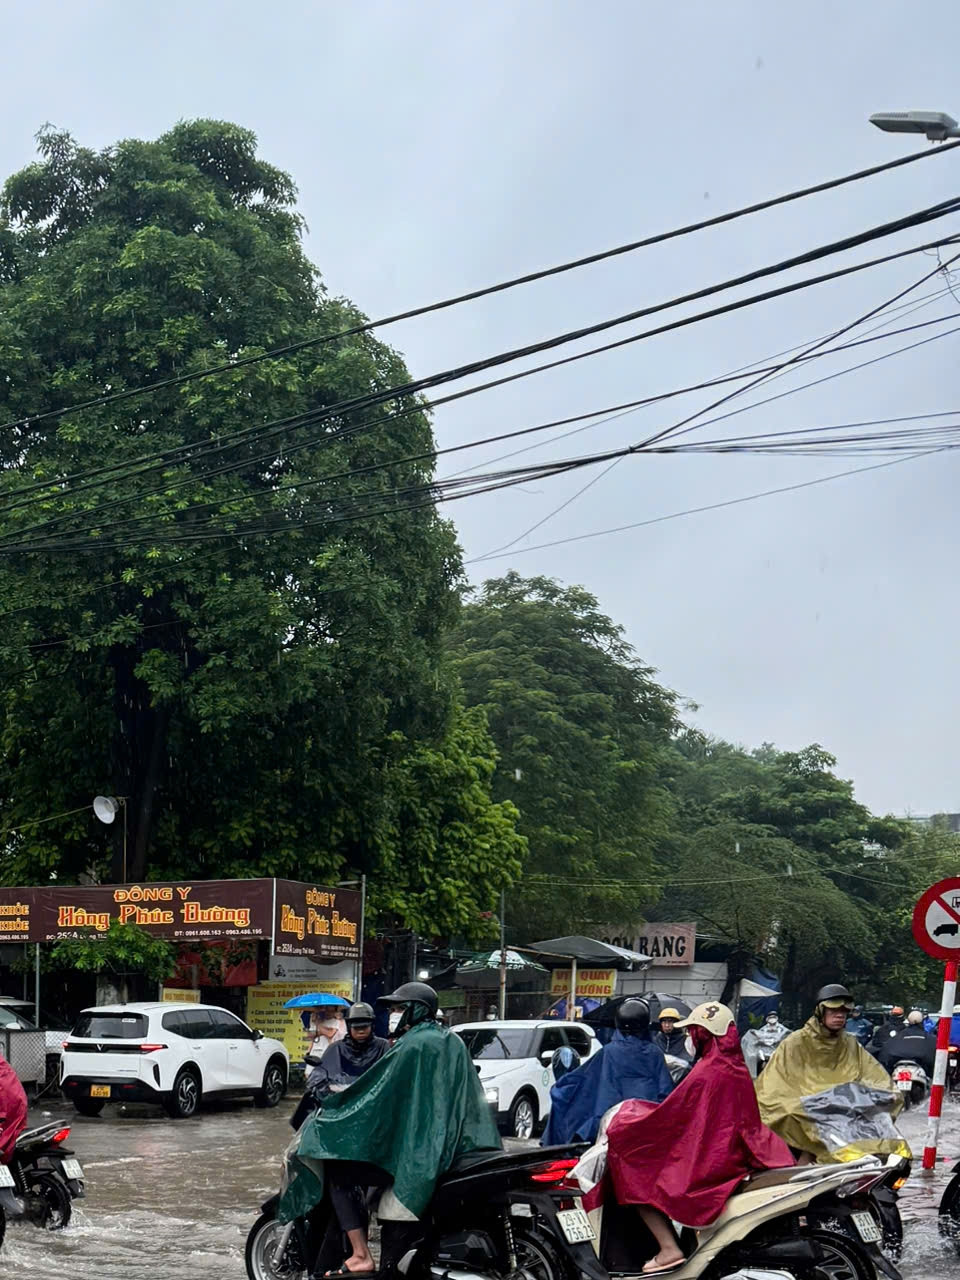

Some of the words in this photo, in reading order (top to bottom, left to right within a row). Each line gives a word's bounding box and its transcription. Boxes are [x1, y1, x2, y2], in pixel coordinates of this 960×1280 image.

[114, 886, 173, 902] ĐÔNG
[176, 886, 192, 900] Y
[329, 893, 336, 908] Y
[118, 904, 174, 925] Phúc
[639, 935, 687, 958] RANG
